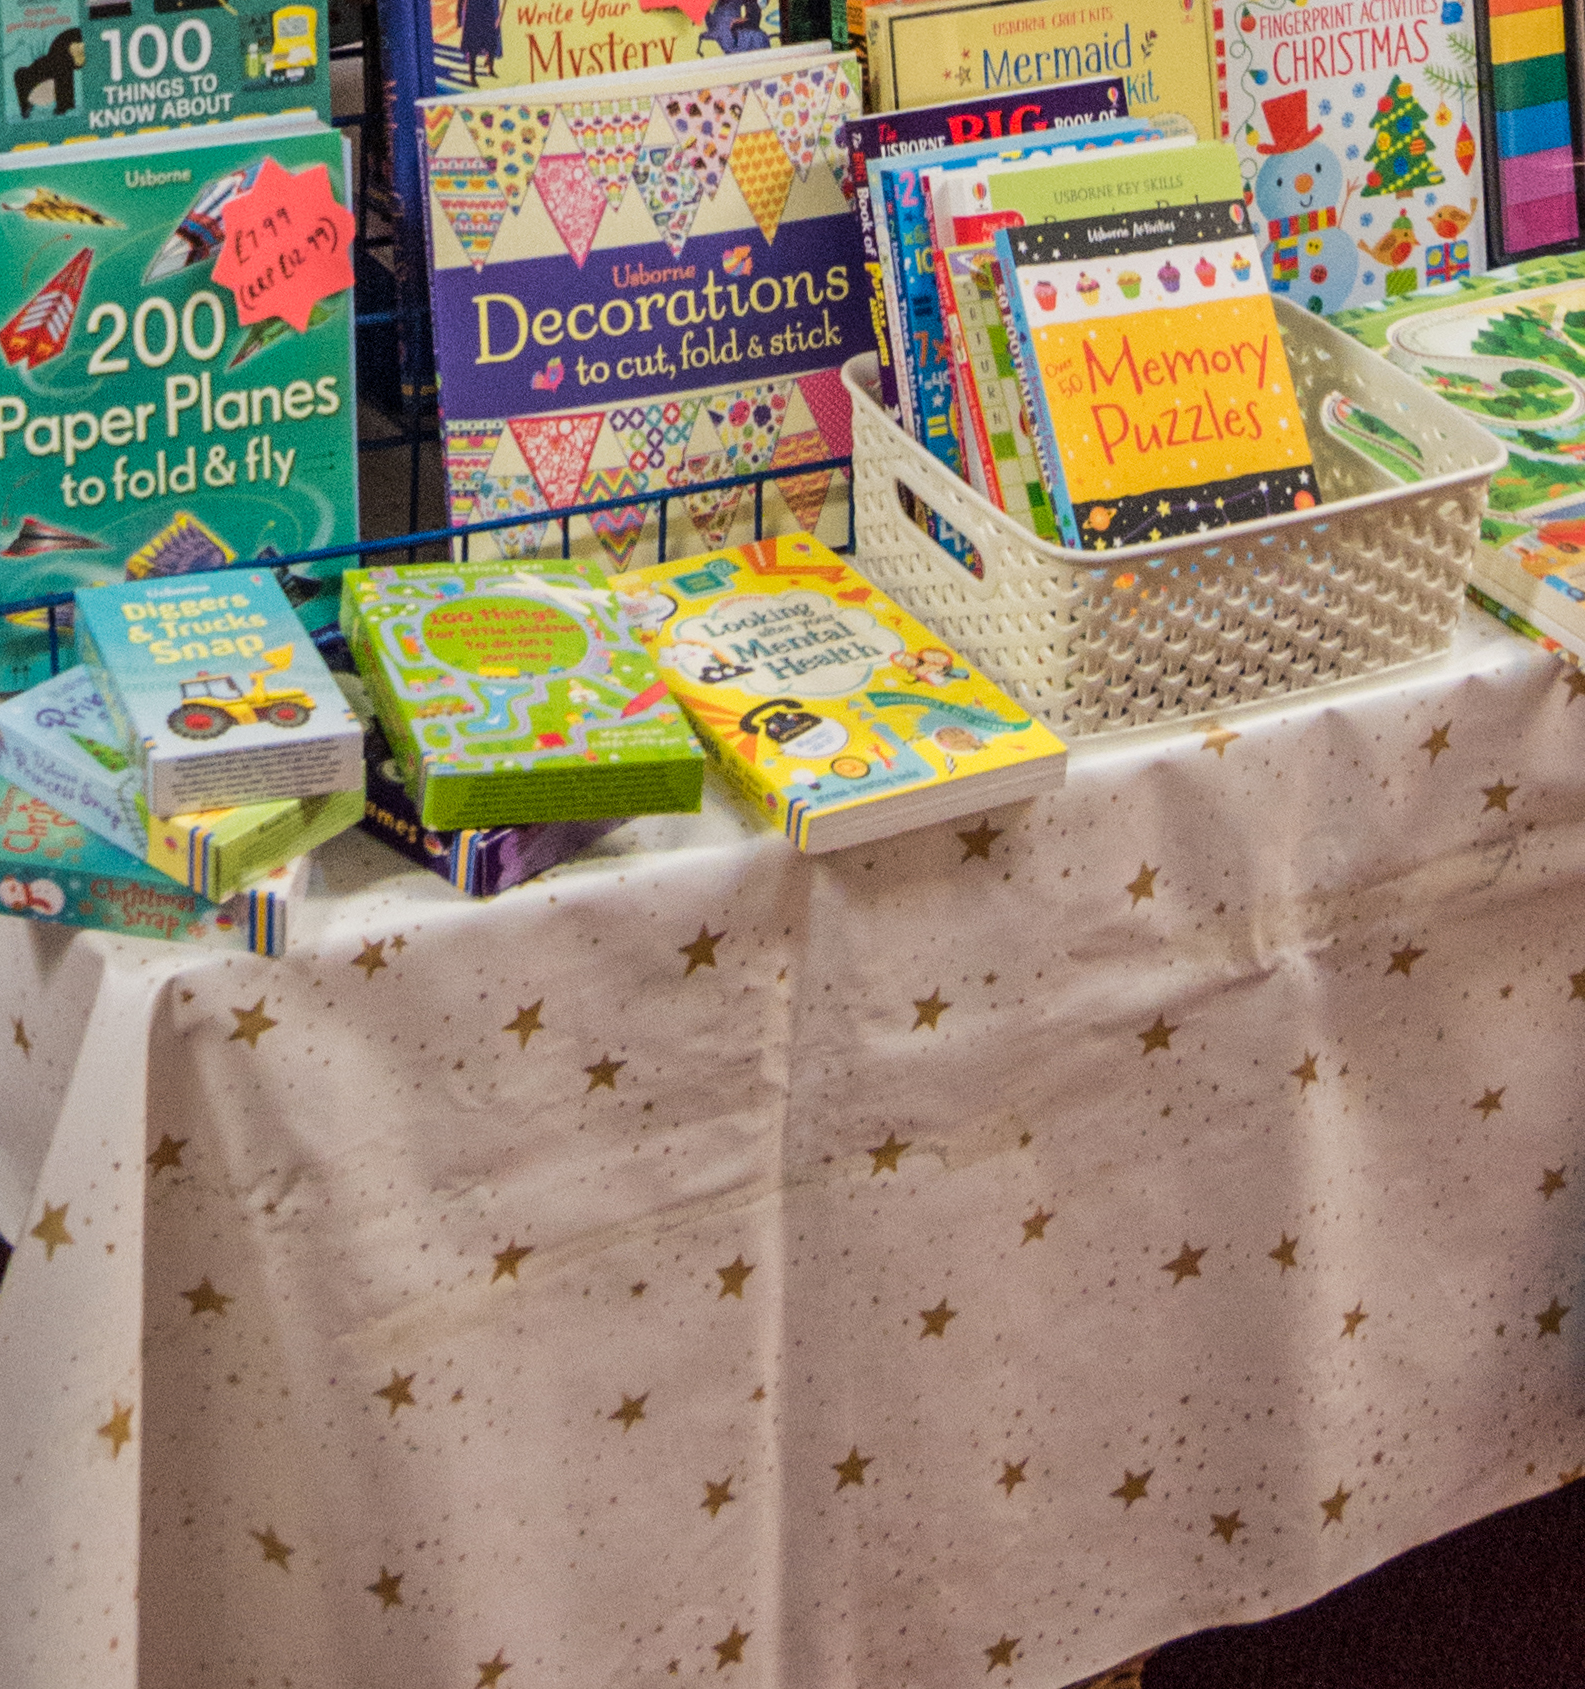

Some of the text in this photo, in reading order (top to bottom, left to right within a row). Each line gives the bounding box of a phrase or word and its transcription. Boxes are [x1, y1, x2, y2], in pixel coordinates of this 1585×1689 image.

[1259, 2, 1354, 40] FINGERPRINT
[100, 18, 213, 82] 100
[527, 29, 678, 83] Mystery
[982, 22, 1133, 90] Mermaid
[1272, 20, 1431, 86] CHRISTMAS
[104, 74, 218, 105] THINGS TO
[1125, 69, 1160, 107] Kit
[89, 93, 235, 130] KNOW ABOUT
[125, 168, 192, 190] Usborne
[1054, 174, 1184, 206] USBORNE KEY SKILLS
[612, 262, 697, 289] Usborne
[87, 291, 226, 375] 200
[471, 262, 852, 366] Decorations
[575, 309, 843, 387] to cut, fold & stick
[1082, 333, 1271, 397] Memory
[165, 371, 341, 438] Planes
[1090, 387, 1264, 466] Puzzles
[60, 434, 296, 509] to fold & fly
[121, 590, 250, 623] Diggers
[701, 600, 811, 639] Looking
[149, 633, 267, 666] Snap
[729, 621, 857, 663] Mental
[764, 641, 882, 681] Health
